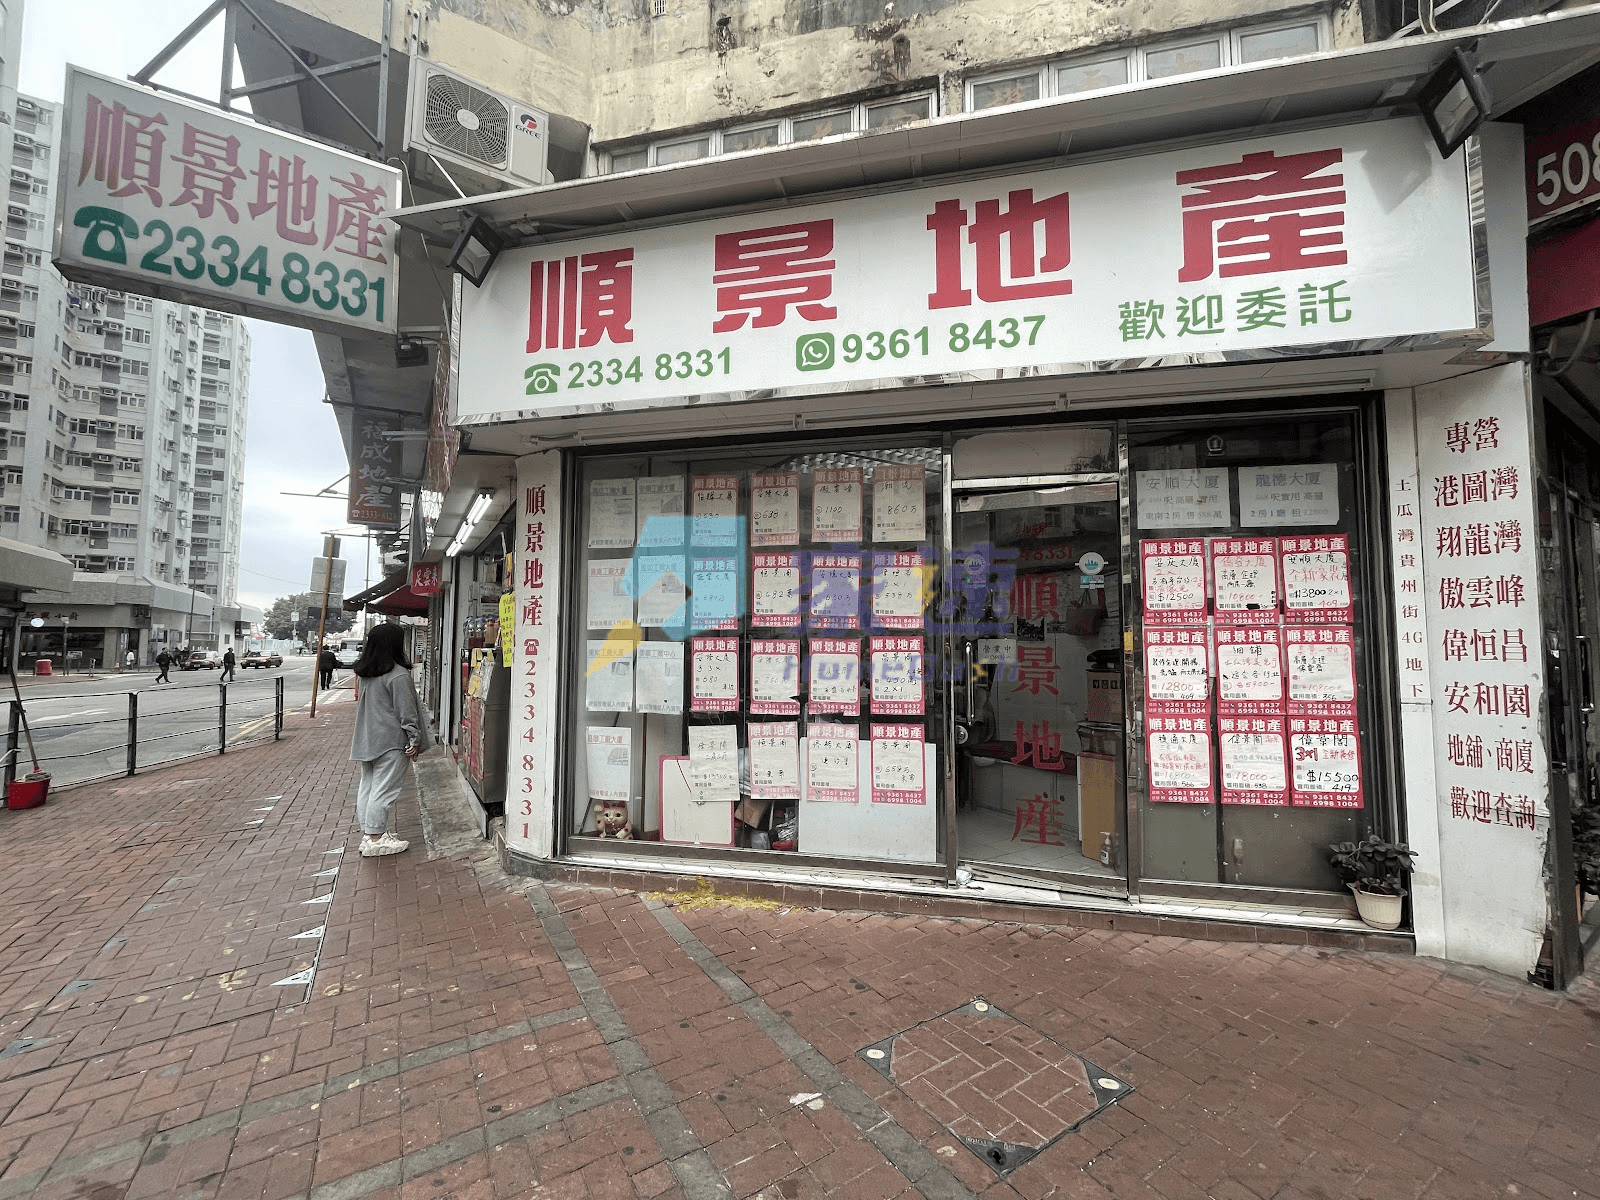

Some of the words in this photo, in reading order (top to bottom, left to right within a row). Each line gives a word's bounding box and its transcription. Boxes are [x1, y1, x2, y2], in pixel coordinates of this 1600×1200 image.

[515, 124, 541, 140] GREE
[77, 94, 388, 264] 順景地產
[525, 148, 1348, 353] 順景地產
[140, 220, 271, 295] 2334
[281, 252, 386, 321] 8331
[1118, 279, 1353, 344] 歡迎委託
[842, 327, 929, 363] 9361
[948, 314, 1047, 353] 8437
[567, 356, 643, 388] 2334
[654, 346, 731, 380] 8331
[1444, 416, 1500, 454] 專營
[754, 475, 797, 486] 順景地產
[816, 471, 861, 482] 順景地產
[1146, 475, 1220, 490] 安順大廈
[1255, 472, 1321, 487] 龍德大廈
[695, 478, 737, 489] 順景地產
[1434, 465, 1519, 507] 港圖灣
[1282, 537, 1345, 552] 順景地產
[1436, 519, 1522, 558] 翔龍灣
[1144, 542, 1202, 554] 順景地產
[1214, 541, 1273, 553] 順景地產
[522, 484, 547, 626] 順景地產
[754, 555, 799, 566] 順景地產
[813, 556, 859, 567] 順景地產
[874, 555, 922, 565] 順景地產
[693, 559, 736, 571] 順景地產
[1439, 574, 1526, 609] 傲雲峰
[1147, 631, 1204, 643] 順景地產
[1218, 629, 1277, 642] 順景地產
[1287, 629, 1349, 642] 順景地產
[694, 640, 737, 650] 順景地產
[754, 642, 798, 653] 順景地產
[812, 641, 858, 652] 順景地產
[873, 640, 921, 650] 順景地產
[1442, 628, 1527, 662] 偉恒昌
[522, 660, 536, 743] 2334
[1444, 681, 1531, 718] 安和園
[1008, 573, 1066, 847] 順景地產
[751, 724, 795, 736] 順景地產
[1149, 718, 1207, 731] 順景地產
[1221, 719, 1282, 732] 順景地產
[1290, 719, 1354, 732] 順景地產
[810, 726, 856, 738] 順景地產
[873, 726, 922, 739] 順景地產
[520, 755, 534, 839] 8331
[1450, 786, 1536, 831] 歡迎查詢
